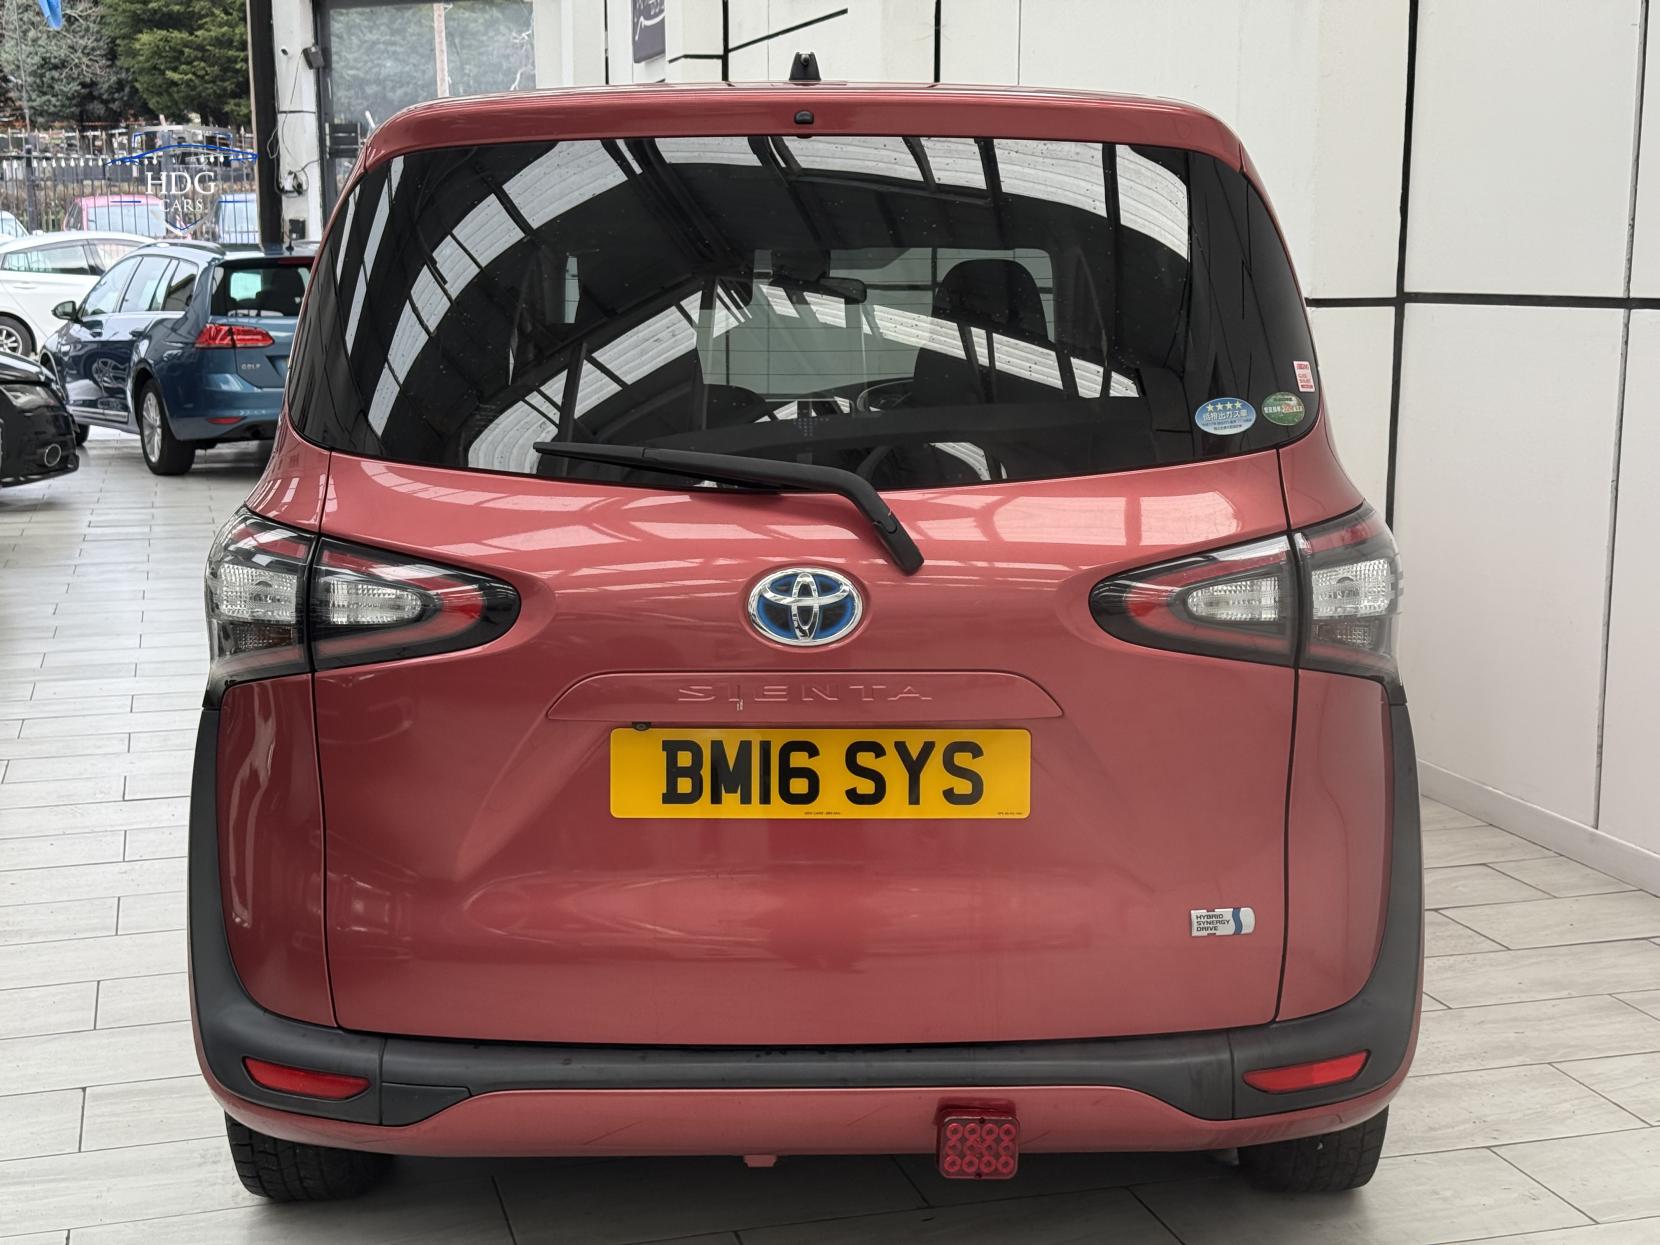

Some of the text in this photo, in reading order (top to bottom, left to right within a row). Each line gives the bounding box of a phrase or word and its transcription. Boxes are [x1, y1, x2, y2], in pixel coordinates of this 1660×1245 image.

[677, 684, 933, 702] SIENTA
[661, 739, 985, 806] BM16 SYS
